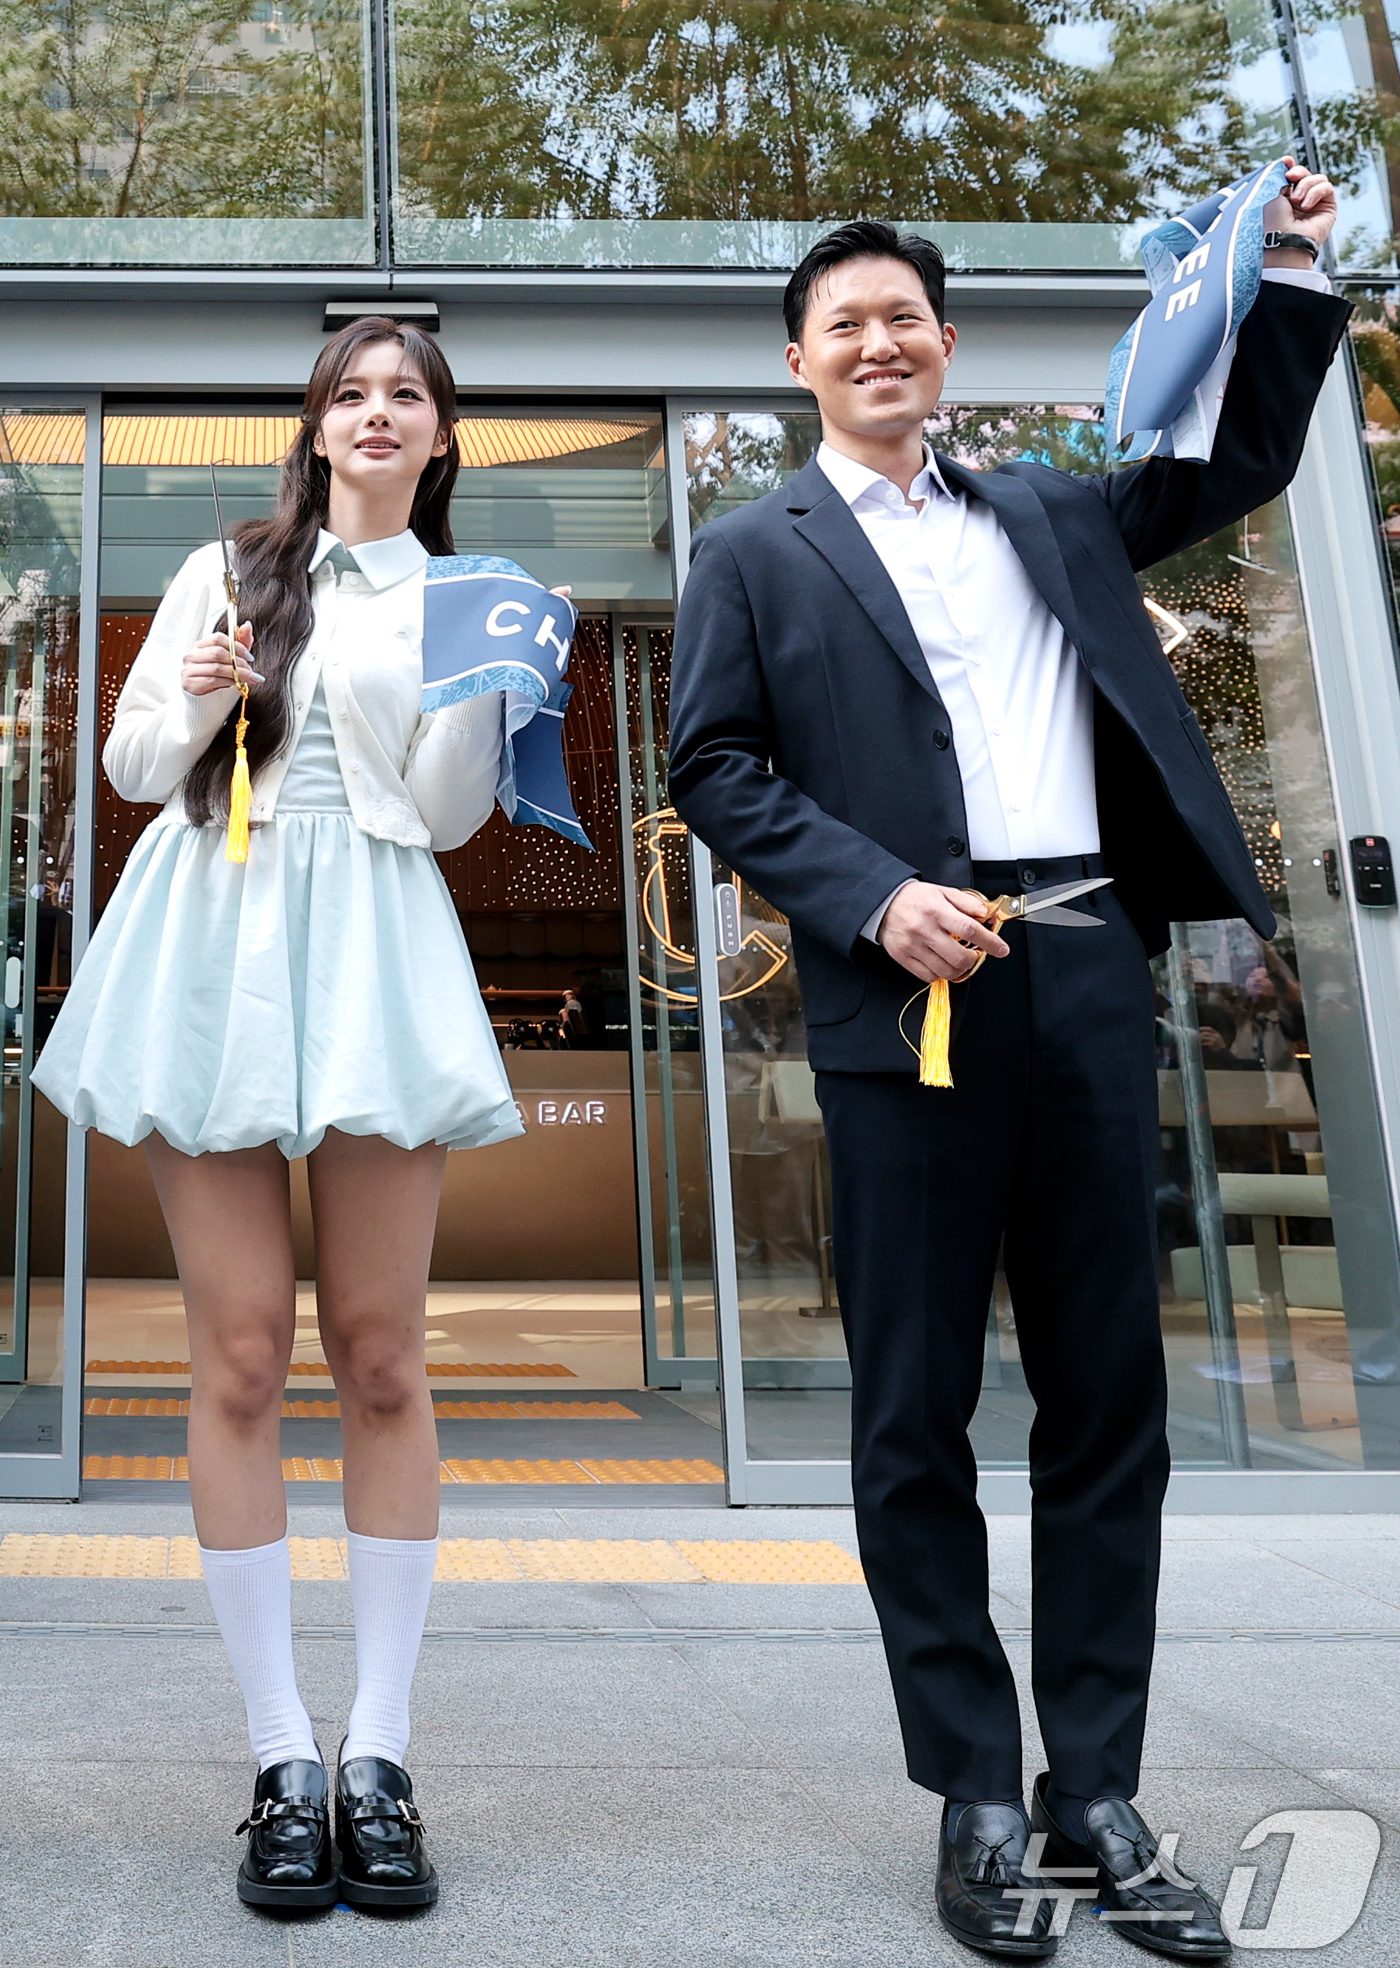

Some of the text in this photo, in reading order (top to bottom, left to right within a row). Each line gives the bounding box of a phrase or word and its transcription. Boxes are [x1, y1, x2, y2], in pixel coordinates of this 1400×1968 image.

[486, 600, 570, 672] CH
[726, 914, 735, 947] PUSH
[538, 1101, 606, 1125] BAR
